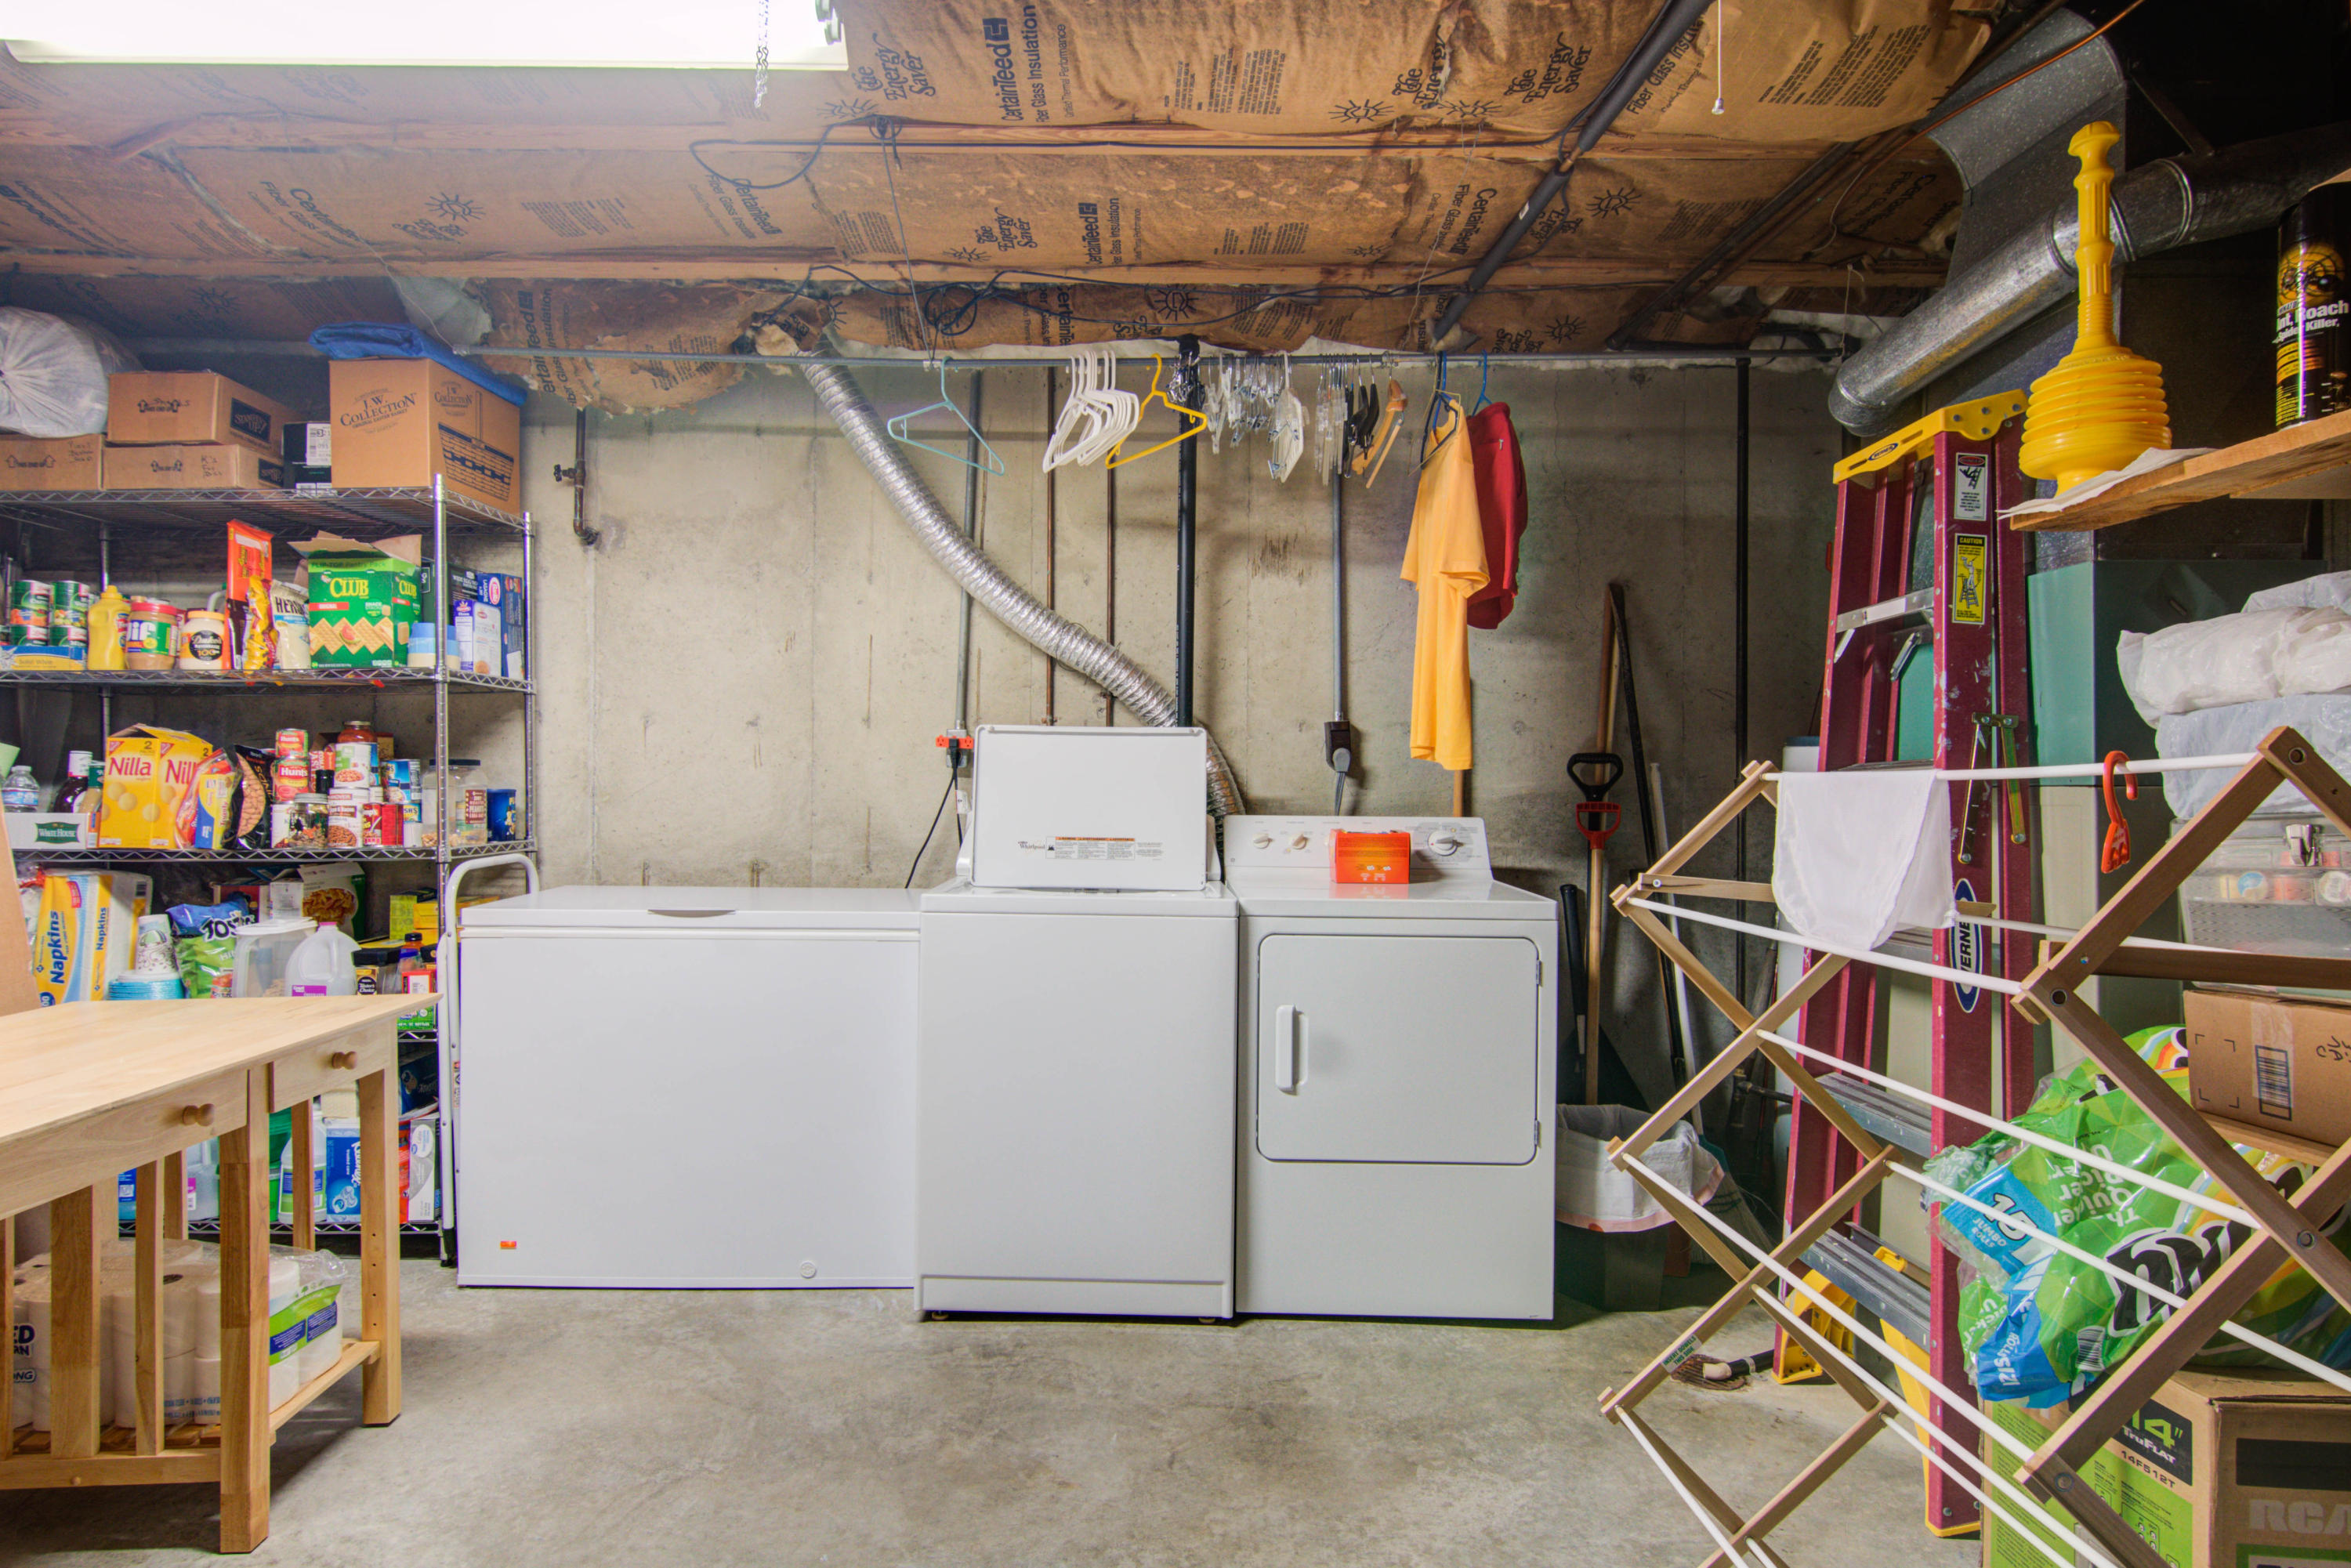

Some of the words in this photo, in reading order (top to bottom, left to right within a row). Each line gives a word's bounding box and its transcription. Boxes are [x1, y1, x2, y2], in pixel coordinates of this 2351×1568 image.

[1020, 3, 1043, 80] Insulation
[872, 31, 909, 101] Energy
[900, 49, 936, 97] Saver
[986, 42, 1024, 122] CertainTeed
[1392, 67, 1423, 96] The
[1504, 68, 1530, 96] The
[1522, 31, 1574, 103] Energy
[1552, 45, 1593, 94] Saver
[1031, 82, 1047, 108] Glass
[1625, 87, 1654, 116] Fiber
[1647, 60, 1675, 87] Glass
[994, 205, 1020, 252] Energy
[1016, 217, 1039, 249] Saver
[1108, 197, 1123, 238] Insulation
[1959, 537, 1983, 545] CAUTION
[329, 577, 369, 598] CLUB
[398, 579, 417, 597] CLUB
[143, 741, 152, 750] 2
[108, 756, 151, 777] Nilla
[50, 910, 68, 985] Napkins
[96, 907, 107, 951] Napkins
[1971, 1226, 1995, 1248] ROLLS
[1972, 1218, 2007, 1247] JUMBO
[2121, 1450, 2176, 1489] 14F512T
